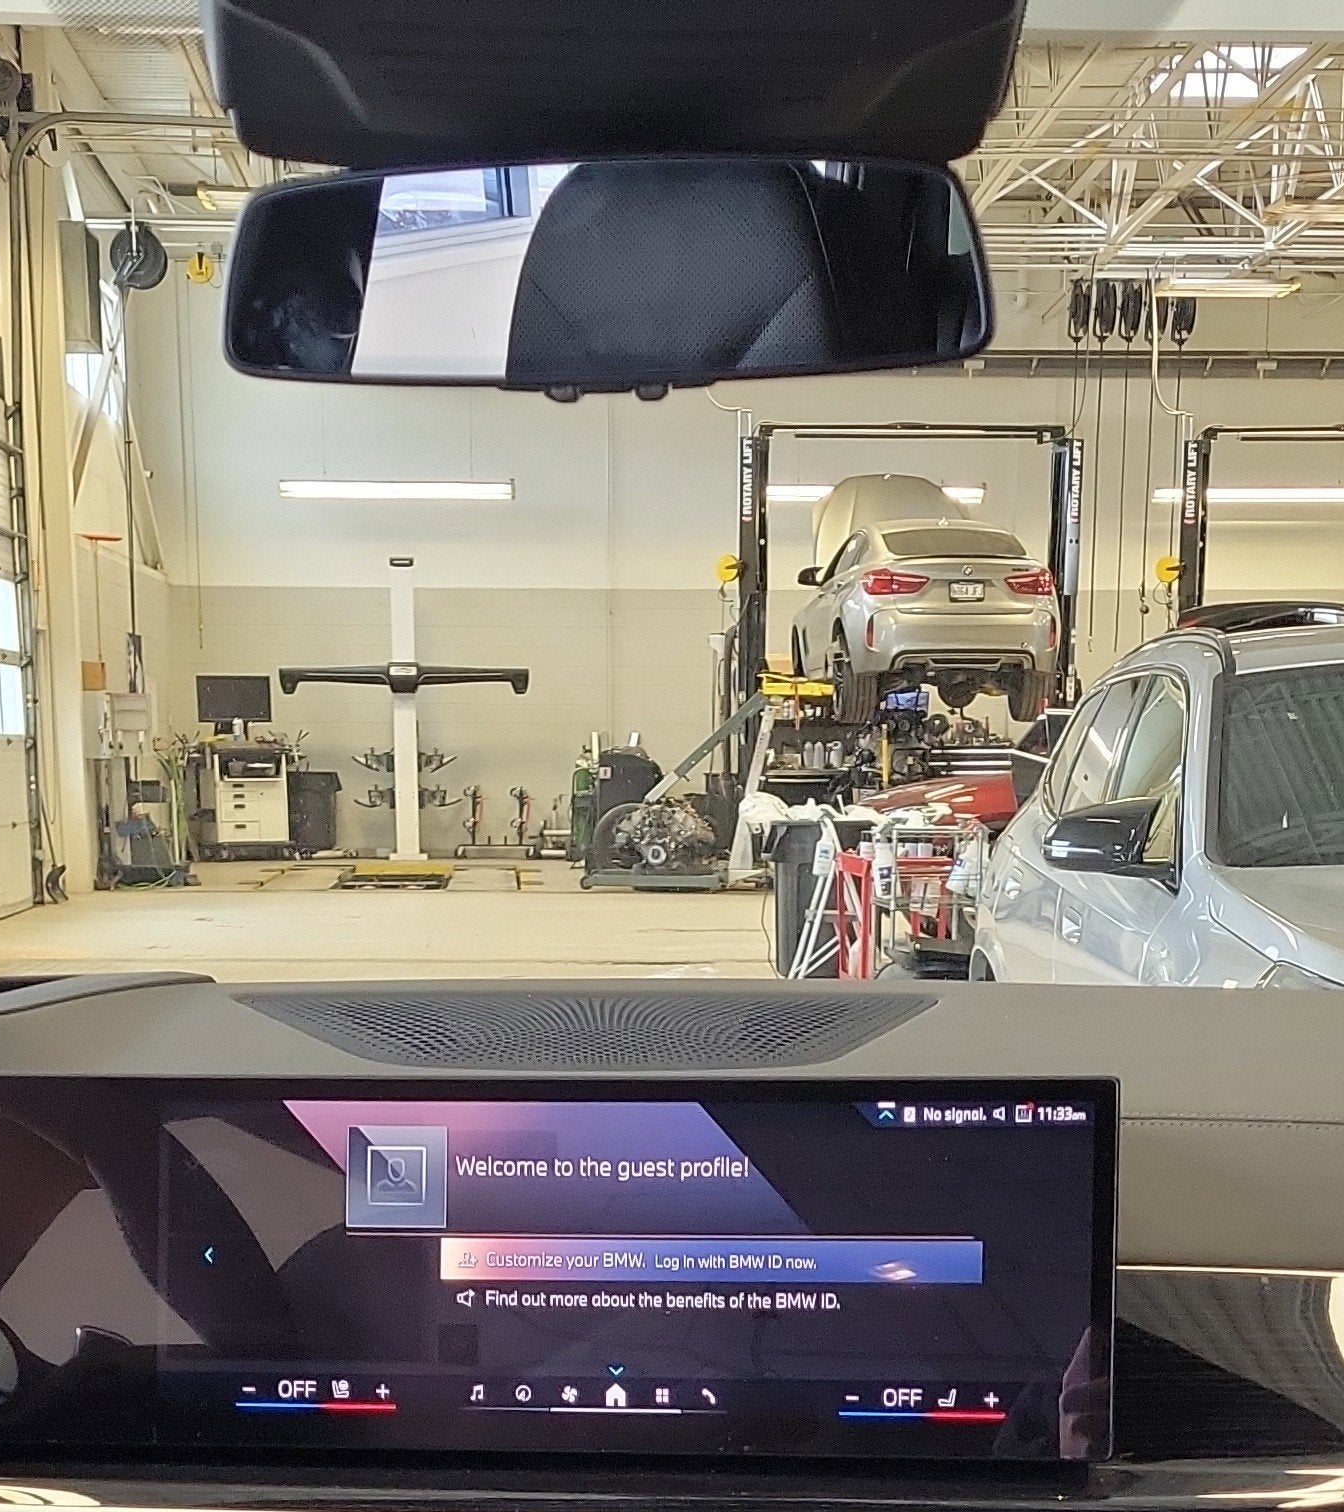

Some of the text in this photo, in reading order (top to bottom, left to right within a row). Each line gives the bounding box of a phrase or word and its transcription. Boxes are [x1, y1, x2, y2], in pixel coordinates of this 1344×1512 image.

[742, 437, 753, 515] ROTARY LIFT
[1070, 440, 1083, 517] ROTARY LIFT
[1185, 442, 1198, 518] ROTARY LIFT
[923, 1106, 942, 1122] No
[945, 1106, 987, 1124] signal.
[455, 1156, 750, 1182] Welcome to the guest profile!
[485, 1252, 563, 1268] Customize
[566, 1255, 600, 1271] your
[602, 1252, 647, 1269] BMW.
[654, 1254, 680, 1272] Log
[697, 1254, 726, 1269] with
[729, 1254, 765, 1269] BMW
[767, 1255, 783, 1269] ID
[785, 1257, 817, 1270] now.
[485, 1290, 841, 1310] Find out more about the benefits of the BMW ID.
[277, 1380, 317, 1398] OFF
[882, 1388, 922, 1408] OFF
